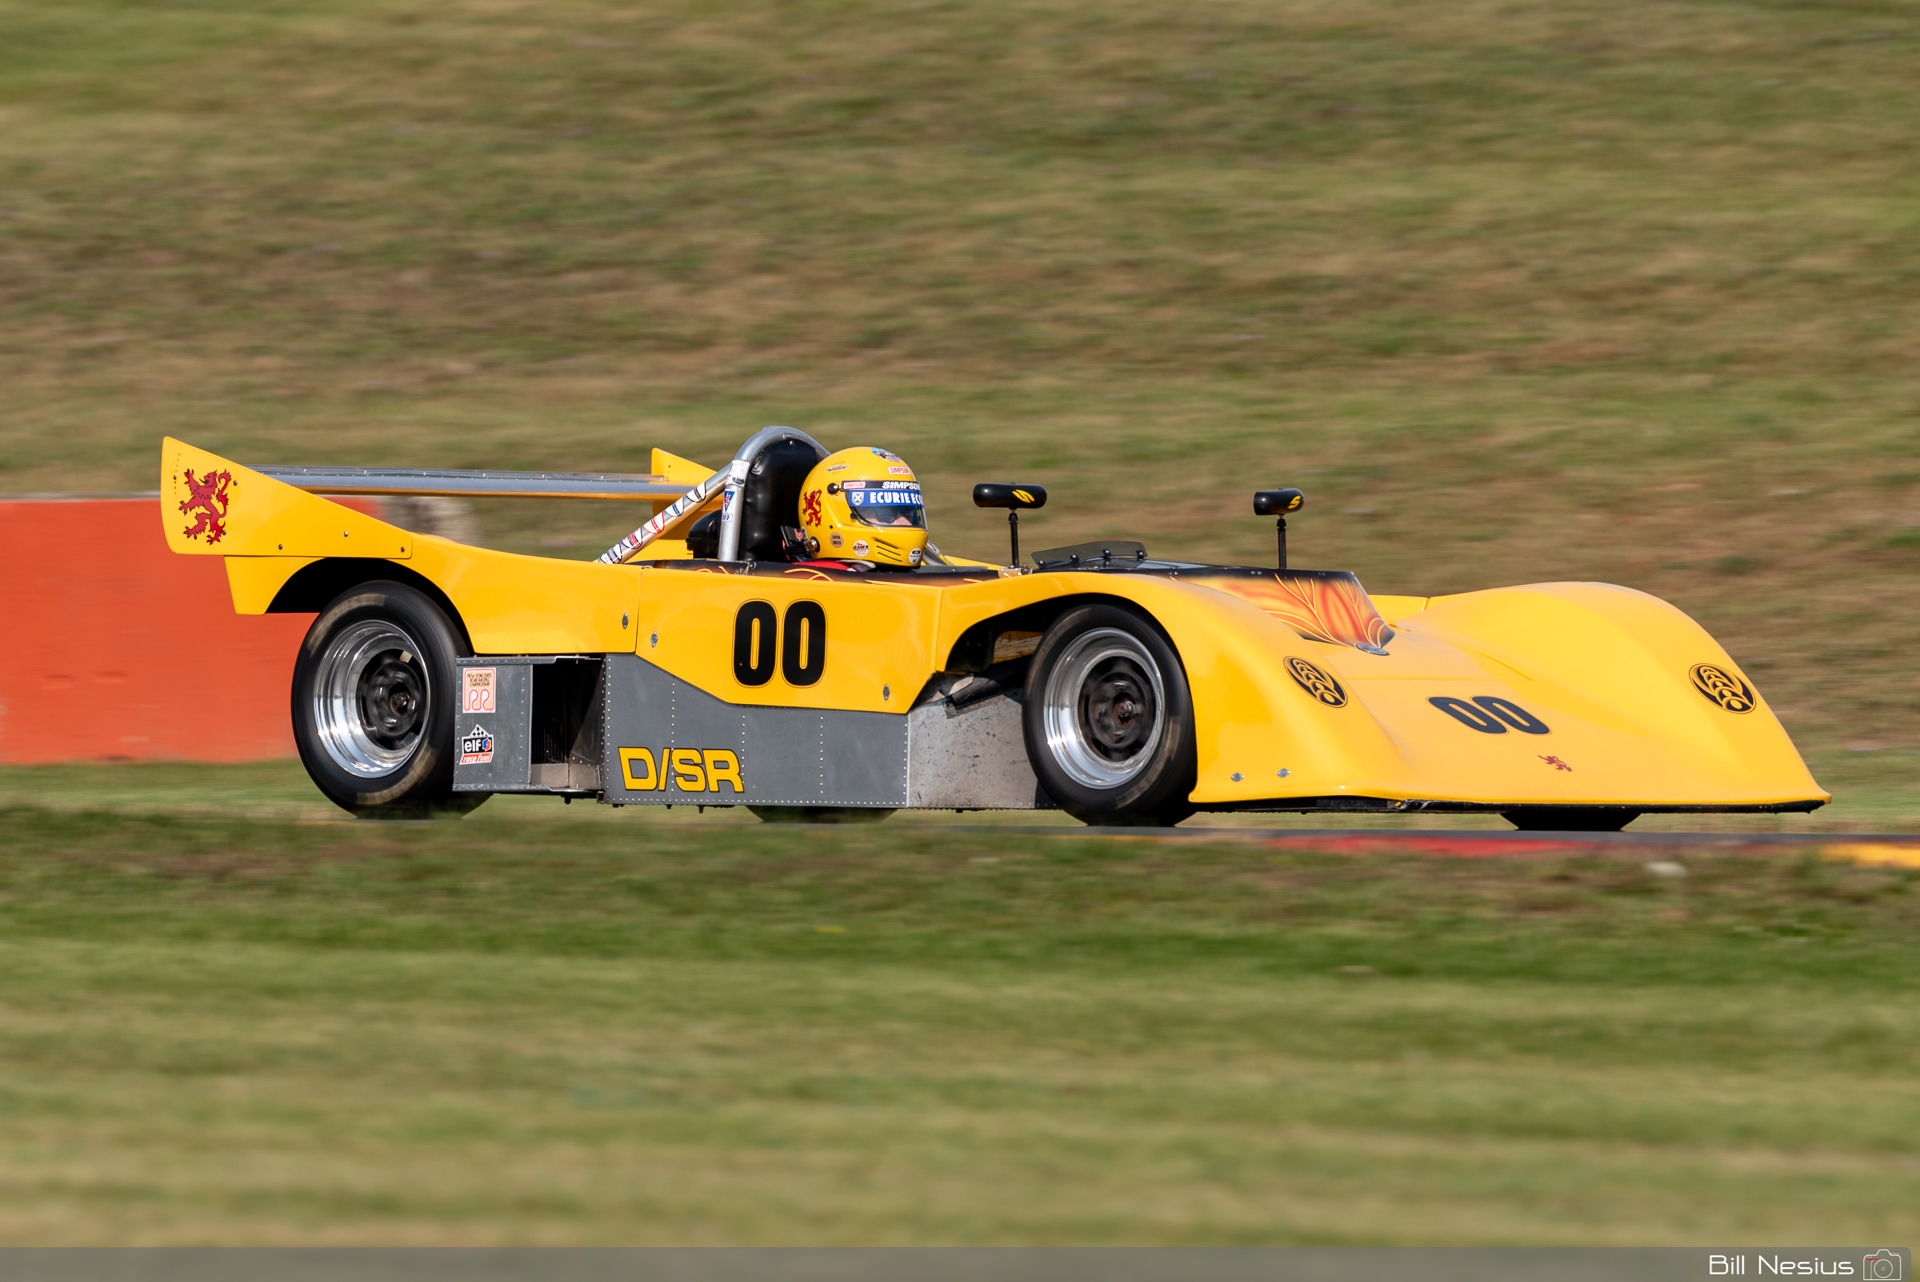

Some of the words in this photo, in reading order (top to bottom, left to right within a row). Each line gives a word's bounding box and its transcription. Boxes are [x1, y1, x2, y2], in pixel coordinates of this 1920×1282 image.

[869, 491, 910, 504] ECURIE
[732, 598, 827, 688] 00
[1427, 695, 1550, 735] 00
[464, 739, 481, 752] elf
[618, 747, 745, 793] D/SR
